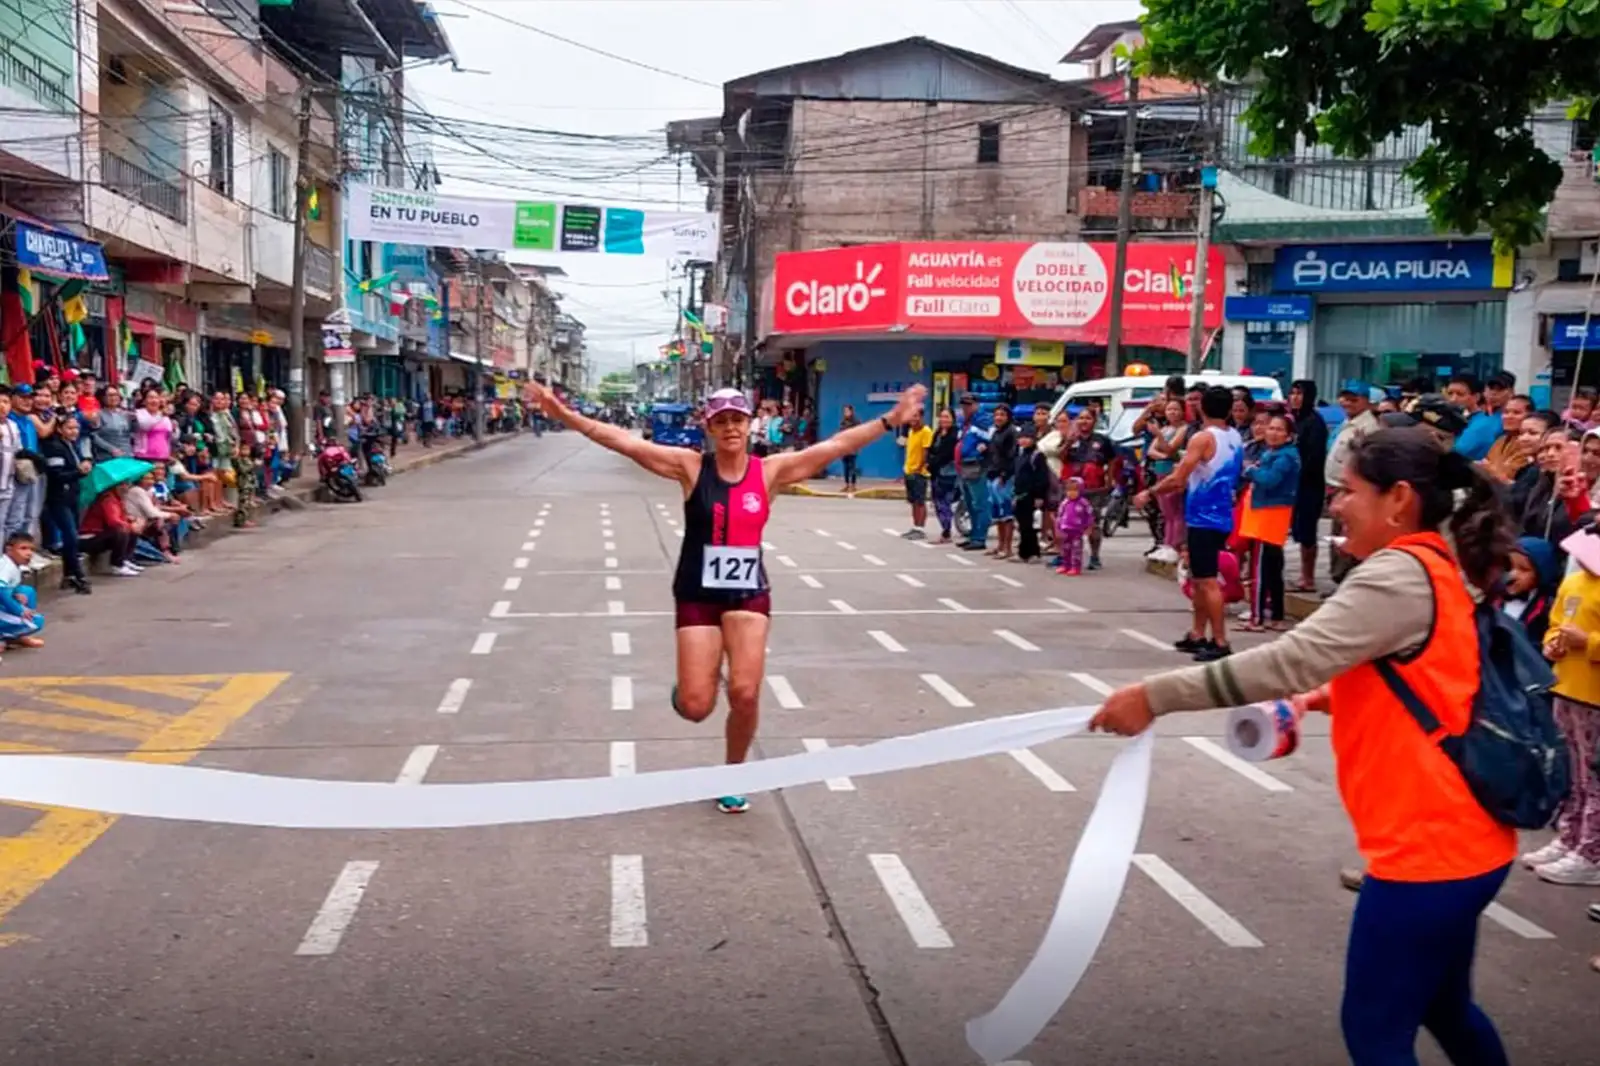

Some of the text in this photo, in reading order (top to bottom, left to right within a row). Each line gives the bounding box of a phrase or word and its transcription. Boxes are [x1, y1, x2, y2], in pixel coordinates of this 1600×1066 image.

[370, 205, 480, 227] EN TU PUEBLO
[908, 249, 984, 268] AGUAYTÍA
[1036, 264, 1087, 276] DOBLE
[1331, 260, 1471, 280] CAJA PIURA
[907, 273, 999, 288] Full velocidad
[1017, 281, 1104, 293] VELOCIDAD
[786, 281, 870, 316] Claro
[914, 299, 990, 313] Full Claro
[709, 557, 757, 580] 127
